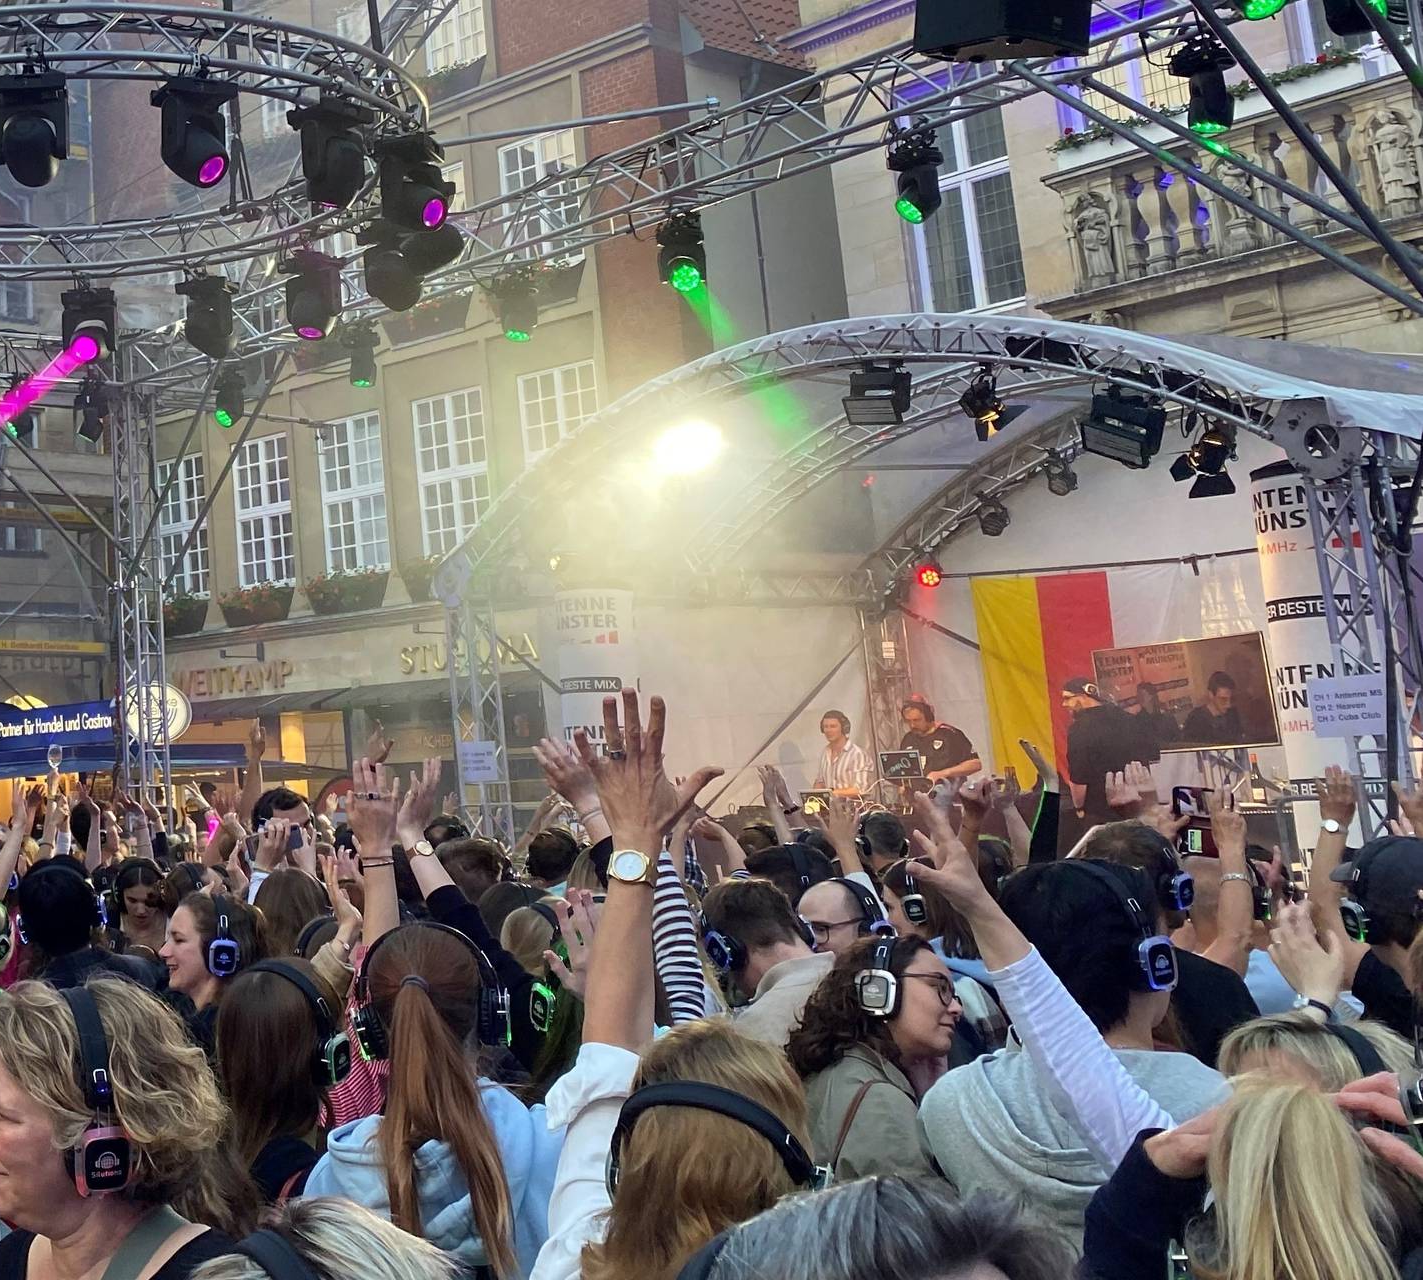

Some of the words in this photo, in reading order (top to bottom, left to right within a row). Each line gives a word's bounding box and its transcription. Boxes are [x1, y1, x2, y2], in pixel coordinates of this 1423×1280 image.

[1279, 600, 1325, 616] BESTE
[24, 718, 35, 735] für
[35, 715, 64, 734] Handel
[65, 713, 80, 731] und
